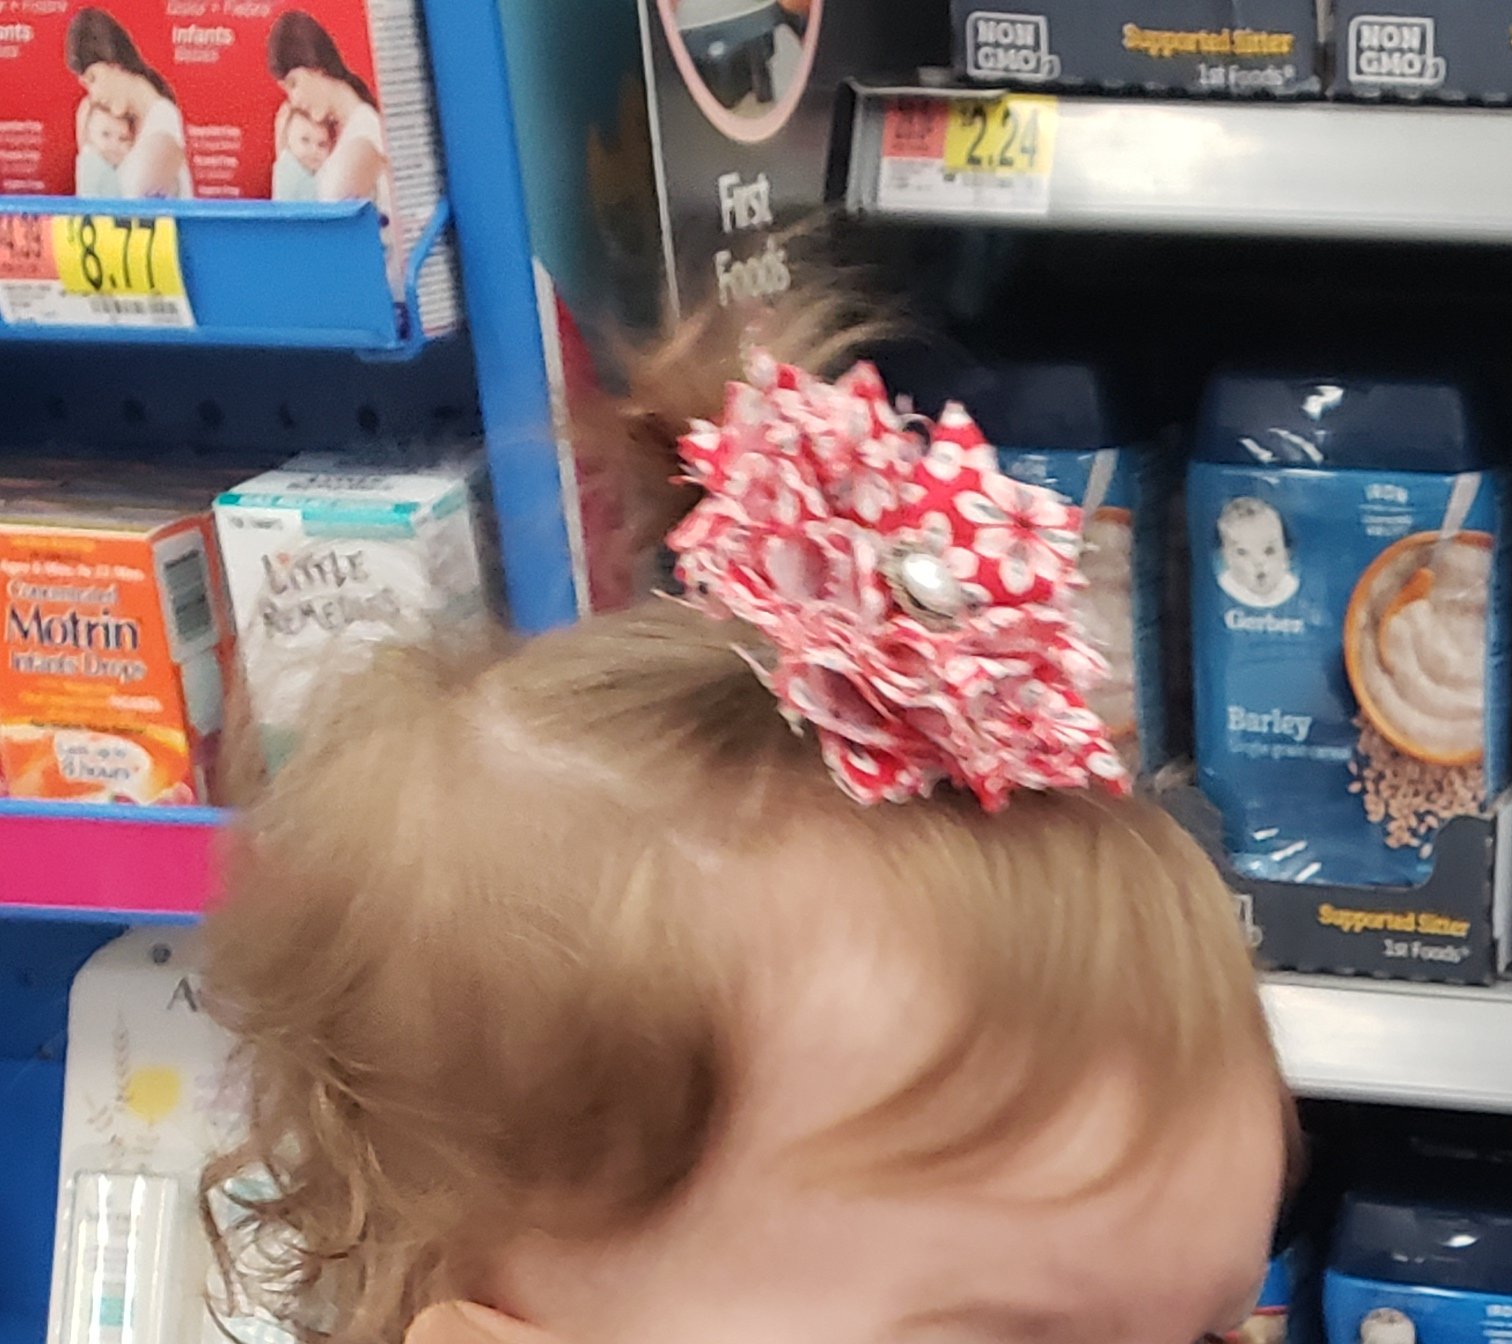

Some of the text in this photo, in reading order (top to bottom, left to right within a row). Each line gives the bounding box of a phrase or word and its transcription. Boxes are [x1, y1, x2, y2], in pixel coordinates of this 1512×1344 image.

[978, 22, 1036, 46] NON
[1359, 26, 1421, 51] NON
[978, 47, 1039, 72] GMO
[1359, 51, 1423, 76] GMO
[6, 602, 139, 650] Motrin
[1227, 706, 1312, 742] Barley
